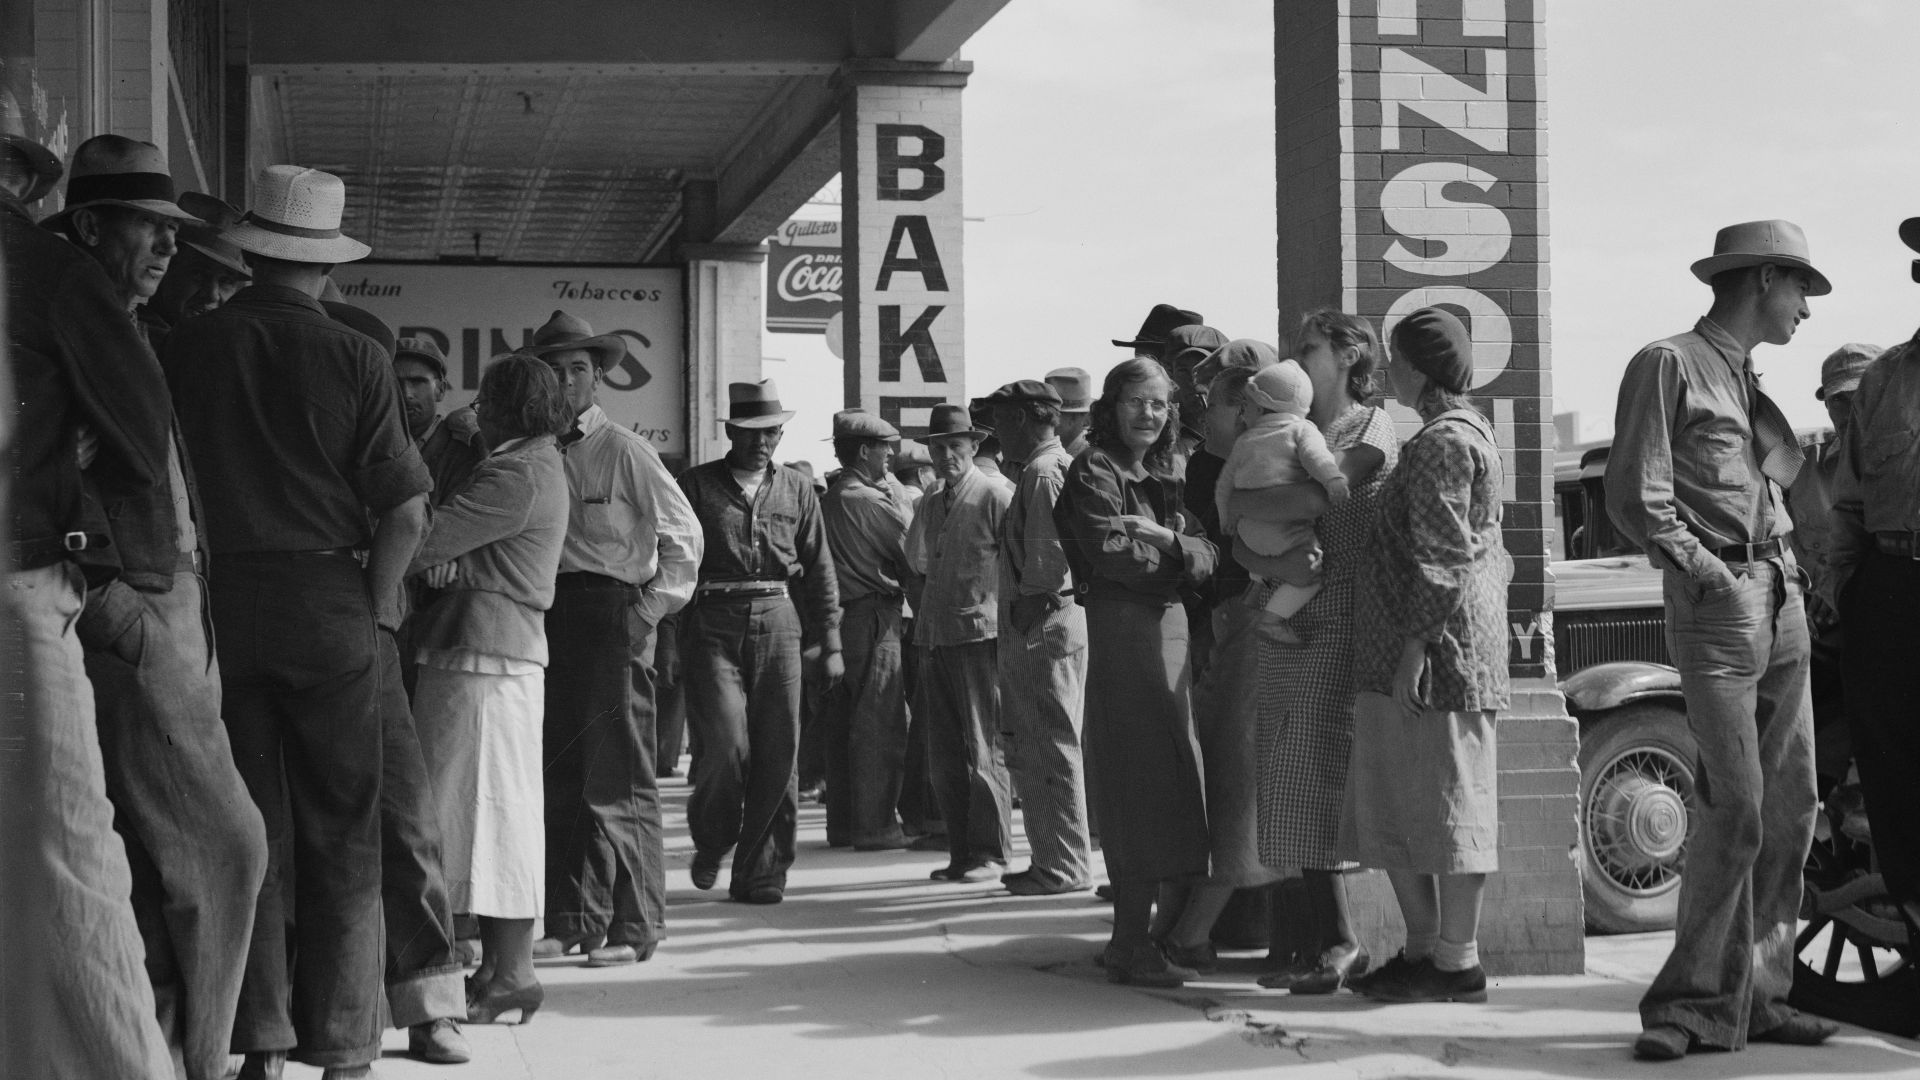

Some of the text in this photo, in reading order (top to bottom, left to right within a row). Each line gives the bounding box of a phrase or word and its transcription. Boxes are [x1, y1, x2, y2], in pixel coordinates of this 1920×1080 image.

[814, 254, 843, 263] DRI
[777, 253, 843, 302] Coca
[552, 280, 662, 302] Tobaccos
